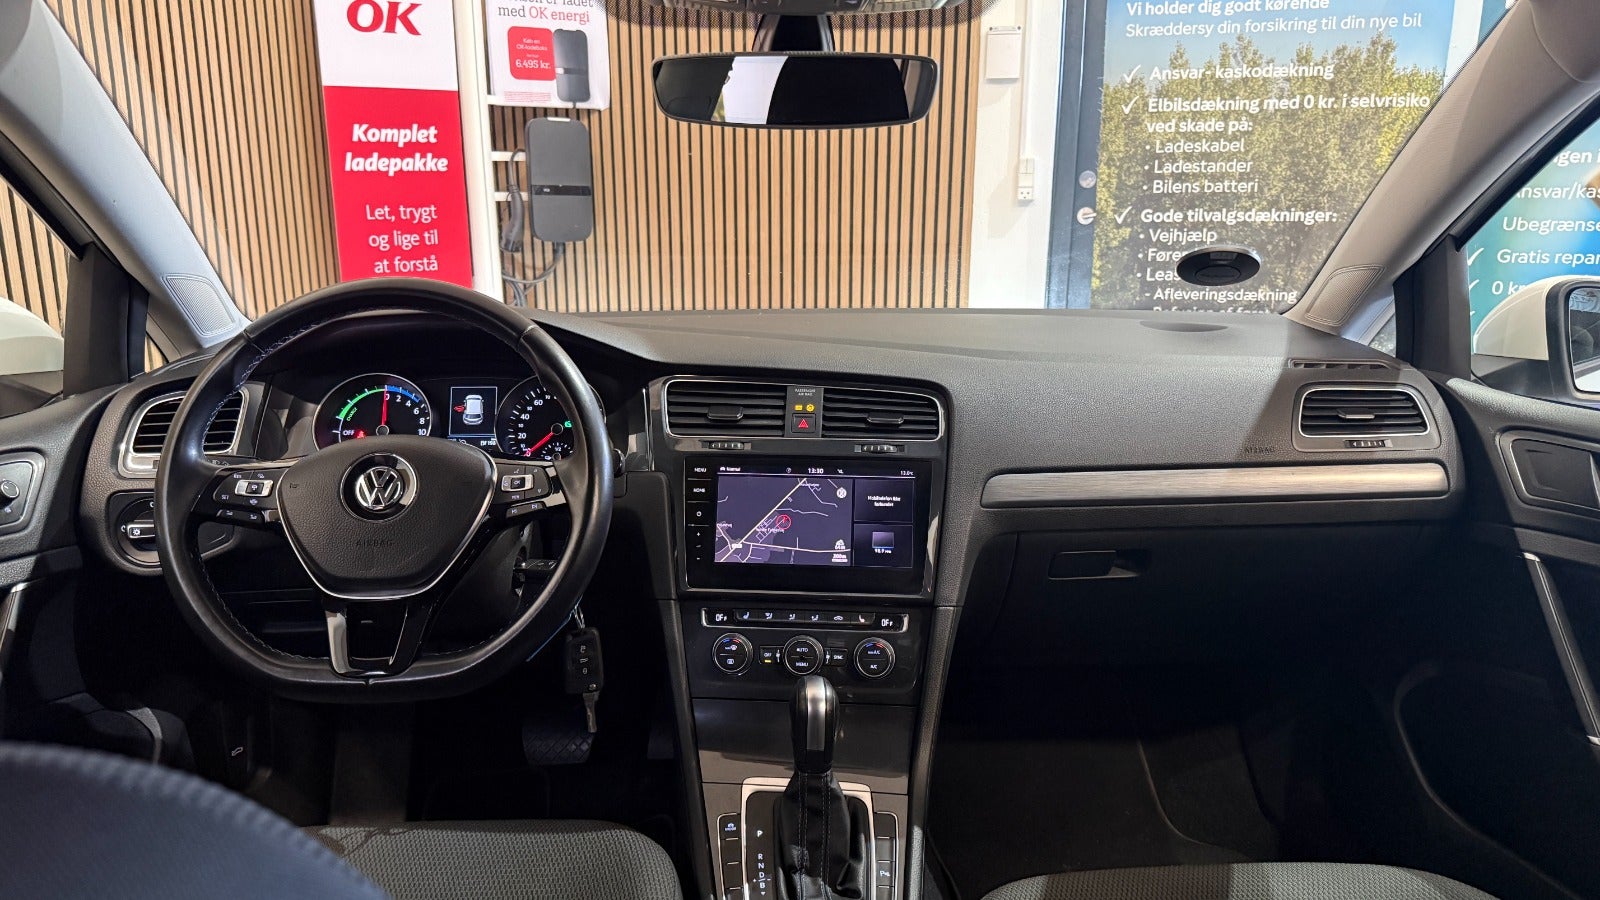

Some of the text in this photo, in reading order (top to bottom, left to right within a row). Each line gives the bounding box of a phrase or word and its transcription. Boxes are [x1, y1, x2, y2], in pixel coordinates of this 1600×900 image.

[347, 0, 422, 35] OK
[498, 5, 590, 25] med OK energi
[1126, 0, 1329, 16] Vi holder dig godt kørende
[1126, 12, 1422, 38] Skræddersy din forsikring til din nye bil
[515, 59, 539, 69] 6.495
[1149, 63, 1335, 81] Ansvar- kaskodækning
[1148, 92, 1431, 114] Elbilsdækning med 0 kr. i selvrisiko
[1147, 116, 1253, 135] ved skade på:
[352, 123, 438, 148] Komplet
[1155, 138, 1245, 154] Ladeskabel
[344, 151, 449, 177] ladepakke
[1154, 159, 1254, 174] Ladestander
[1553, 150, 1593, 167] gen
[1152, 178, 1259, 194] Bilens batteri
[1515, 181, 1600, 201] nsvar/ka
[365, 204, 438, 224] Let, trygt
[1140, 207, 1338, 226] Gode tilvalgsdækninger:
[368, 228, 439, 251] og lige til
[1149, 228, 1218, 245] Vejhjælp
[374, 254, 438, 273] at forstå
[1496, 248, 1550, 264] Gratis
[1153, 287, 1298, 304] Afleveringsdækning
[1491, 280, 1504, 295] 0
